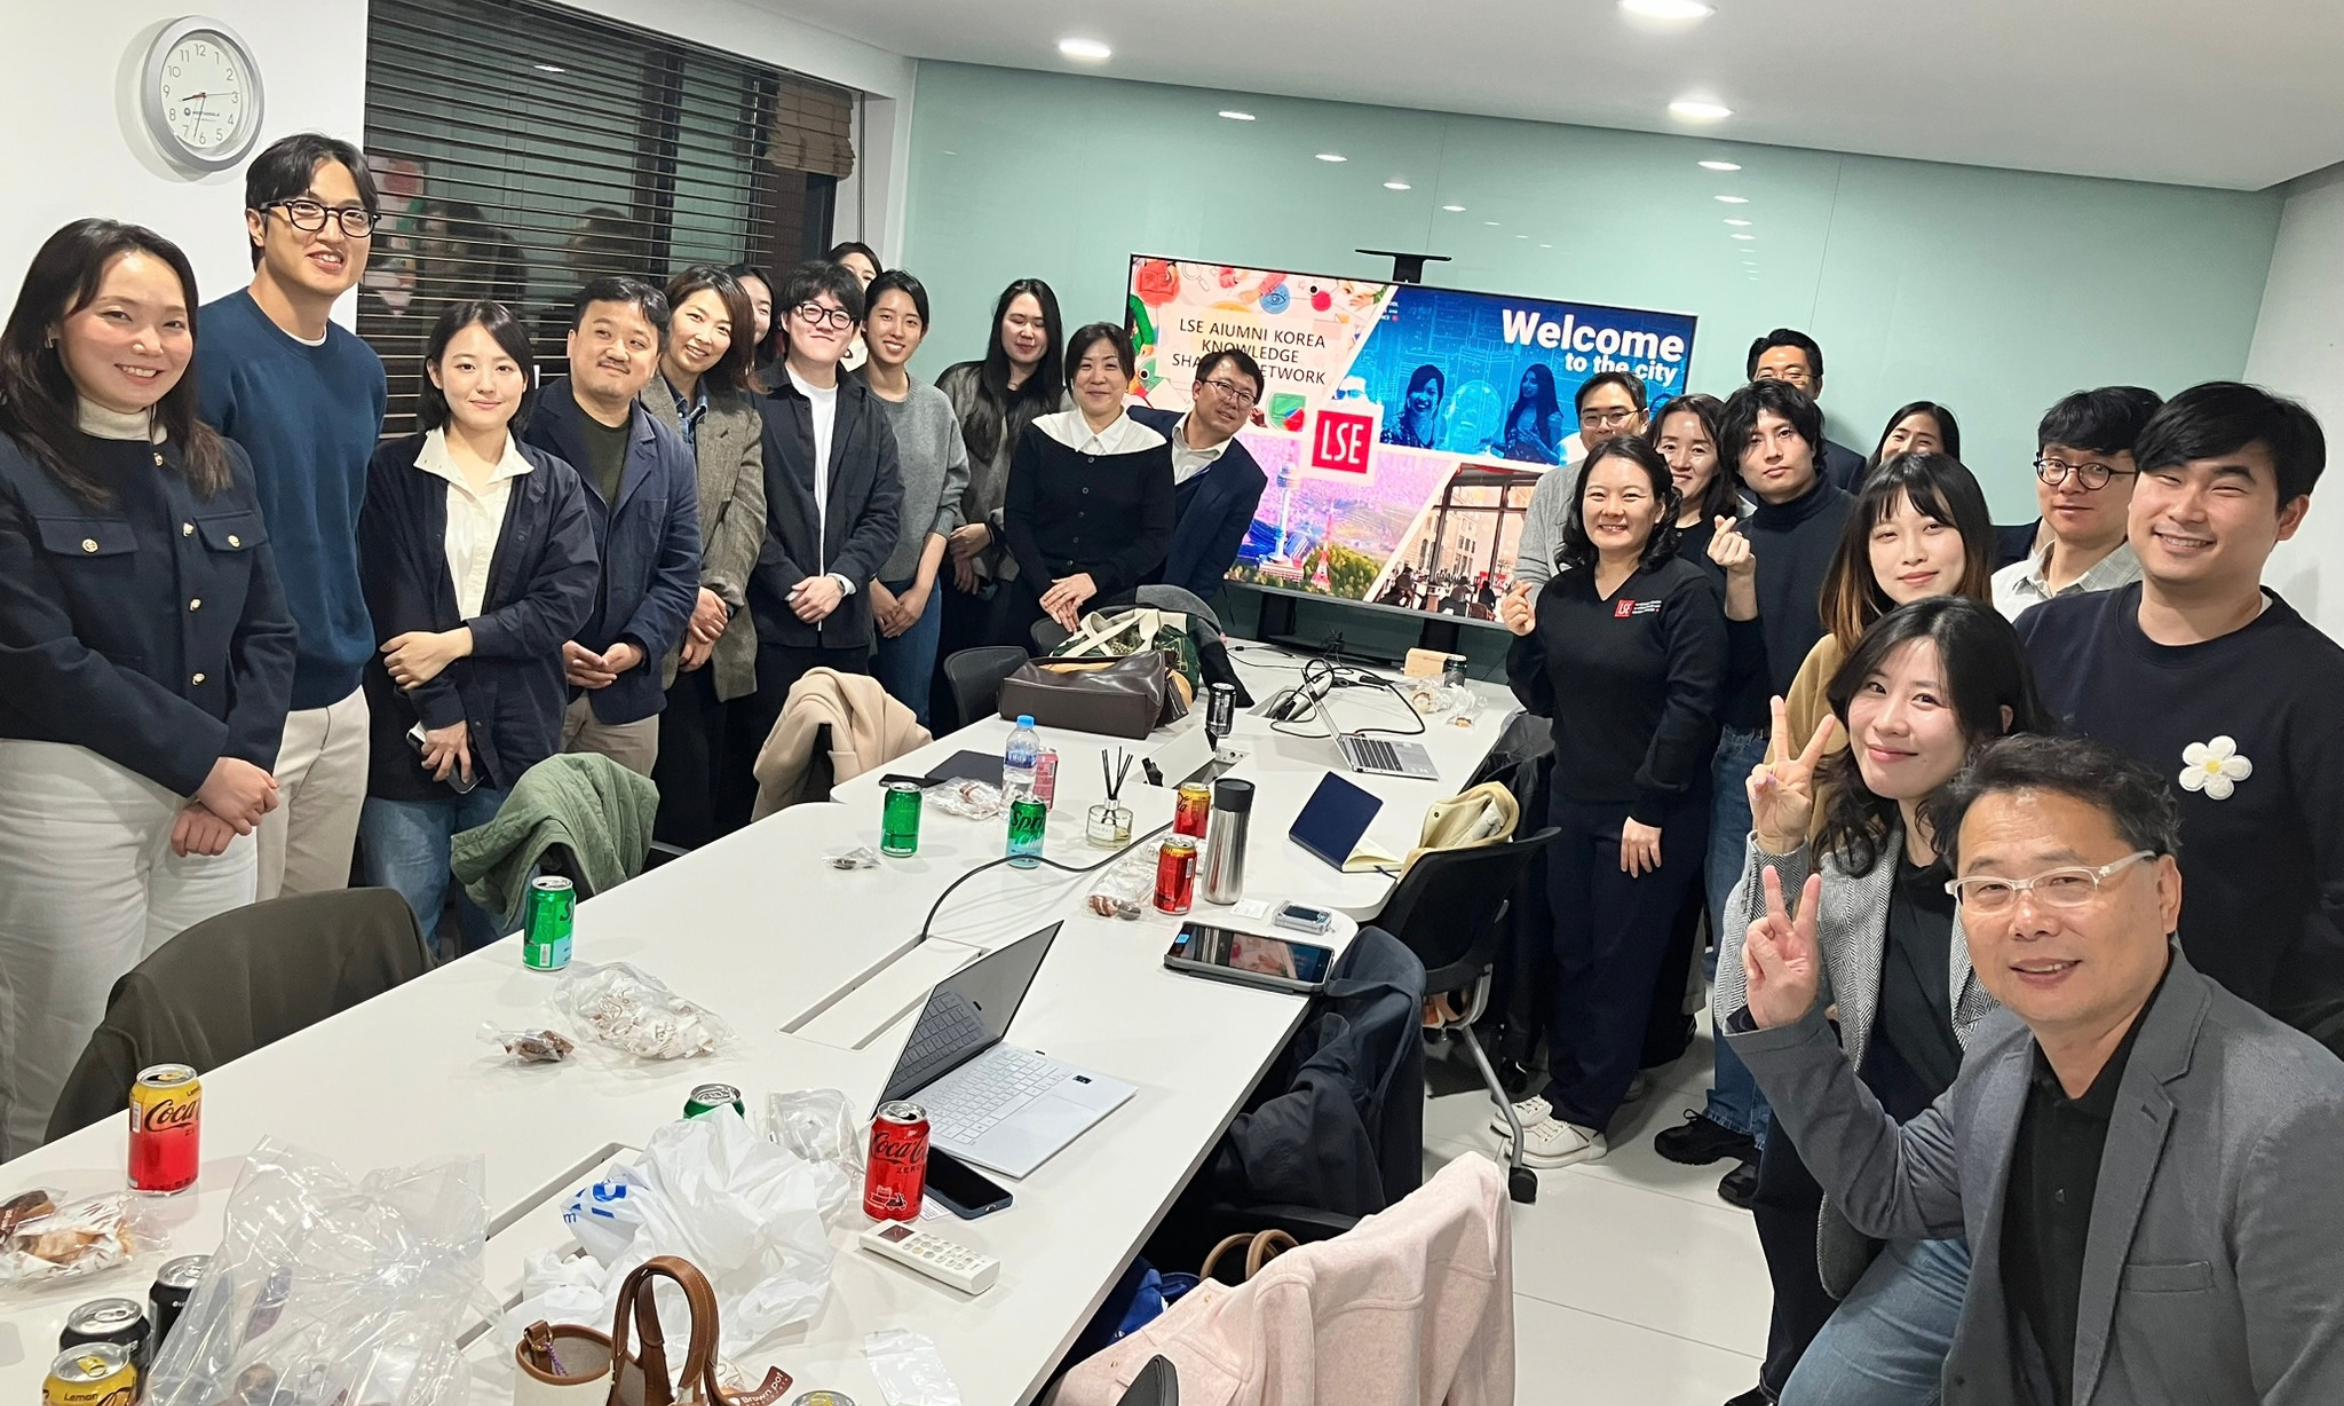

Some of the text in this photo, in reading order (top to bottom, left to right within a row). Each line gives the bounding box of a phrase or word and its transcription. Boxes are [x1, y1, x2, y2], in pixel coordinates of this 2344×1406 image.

[180, 49, 190, 62] 11
[195, 44, 206, 57] 12
[214, 51, 220, 65] 1
[168, 65, 181, 78] 10
[226, 68, 233, 81] 2
[163, 84, 170, 98] 9
[231, 91, 238, 104] 3
[169, 108, 176, 121] 8
[227, 113, 234, 125] 4
[182, 124, 189, 138] 7
[216, 128, 223, 141] 5
[199, 132, 207, 145] 6
[1179, 318, 1204, 334] LSE
[1274, 330, 1326, 349] KOREA
[1502, 308, 1685, 362] Welcome
[1260, 364, 1327, 385] ETWORK
[1565, 352, 1678, 387] to the city
[1320, 419, 1364, 464] LSE
[1617, 602, 1632, 615] LSE
[63, 1392, 98, 1402] Lemon
[741, 1389, 772, 1404] Brown
